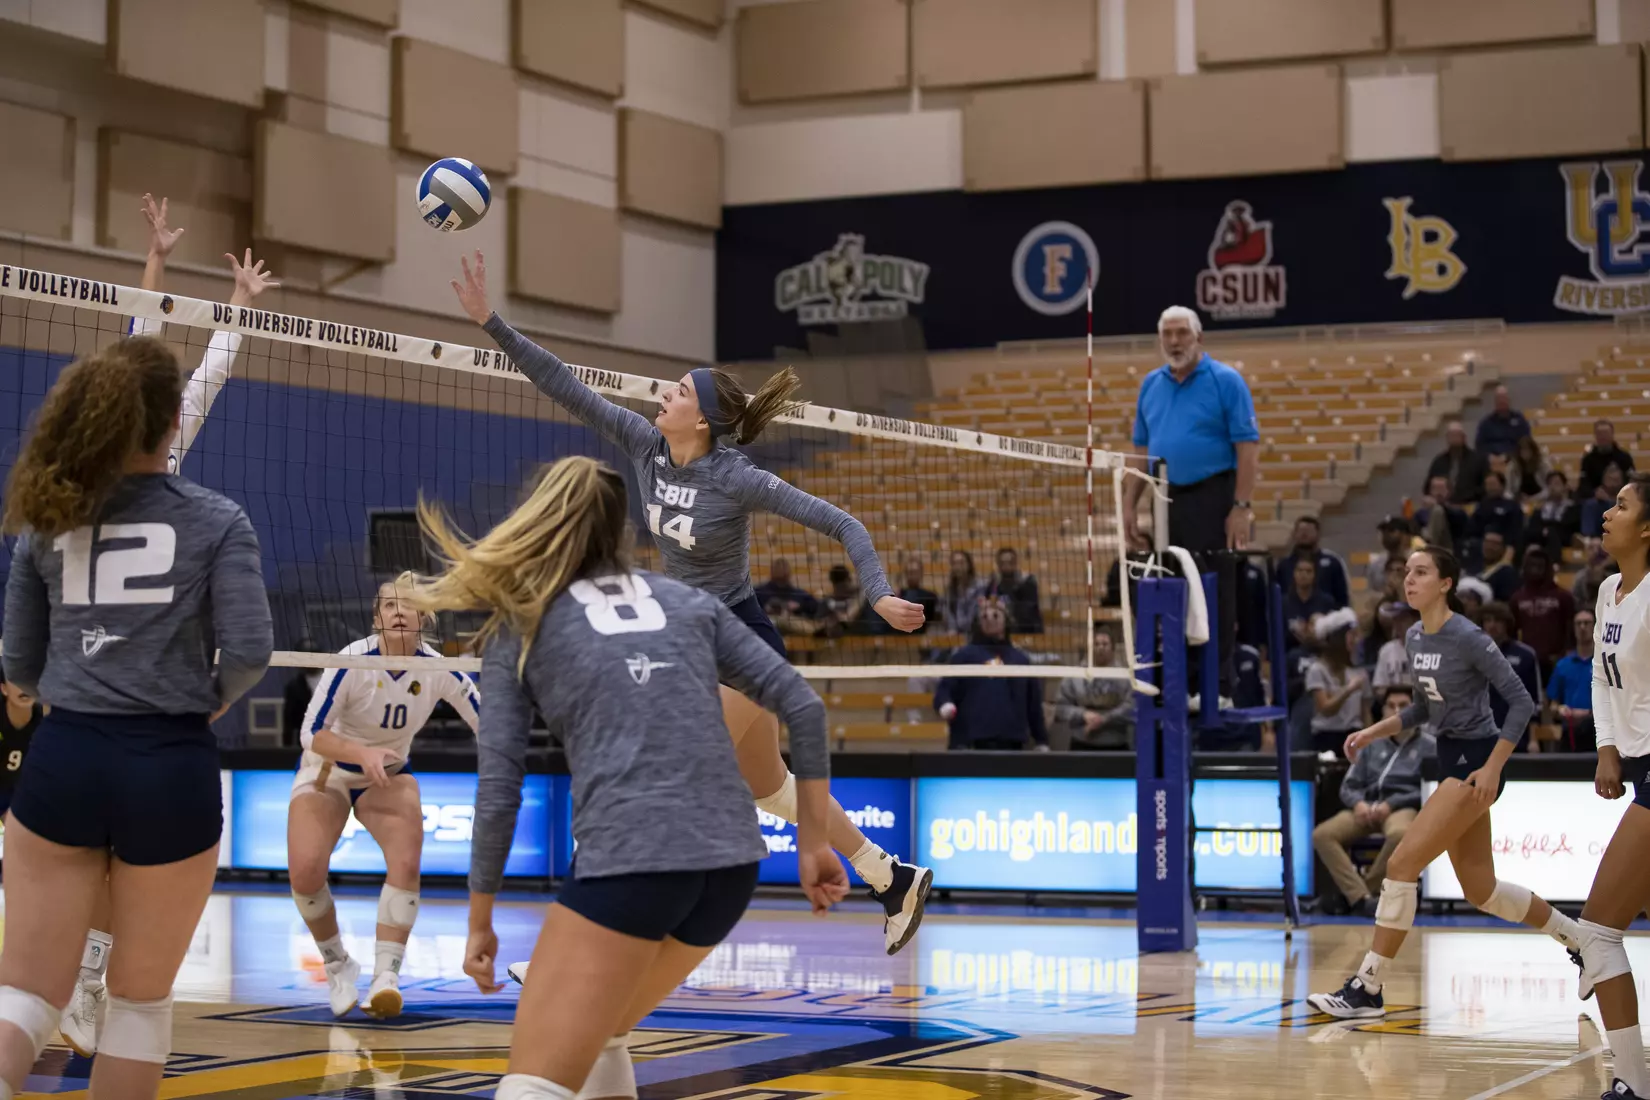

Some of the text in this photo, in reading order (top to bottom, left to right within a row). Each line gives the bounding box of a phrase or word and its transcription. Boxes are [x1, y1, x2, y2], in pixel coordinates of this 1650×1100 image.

[19, 268, 118, 306] VOLLEYBALL
[778, 256, 926, 308] CAL POLY
[1041, 243, 1073, 295] F
[1200, 268, 1282, 306] CSUN
[213, 302, 399, 353] UC RIVERSIDE VOLLEYBALL
[474, 348, 490, 368] UC
[856, 412, 959, 443] UC RIVERSIDE VOLLEYBALL
[654, 477, 699, 509] CBU
[646, 503, 696, 550] 14
[52, 522, 177, 605] 12
[568, 573, 668, 635] 8
[1413, 653, 1441, 671] CBU
[1601, 651, 1624, 689] 11
[1418, 676, 1444, 702] 3
[380, 703, 407, 730] 10
[6, 749, 23, 772] 9
